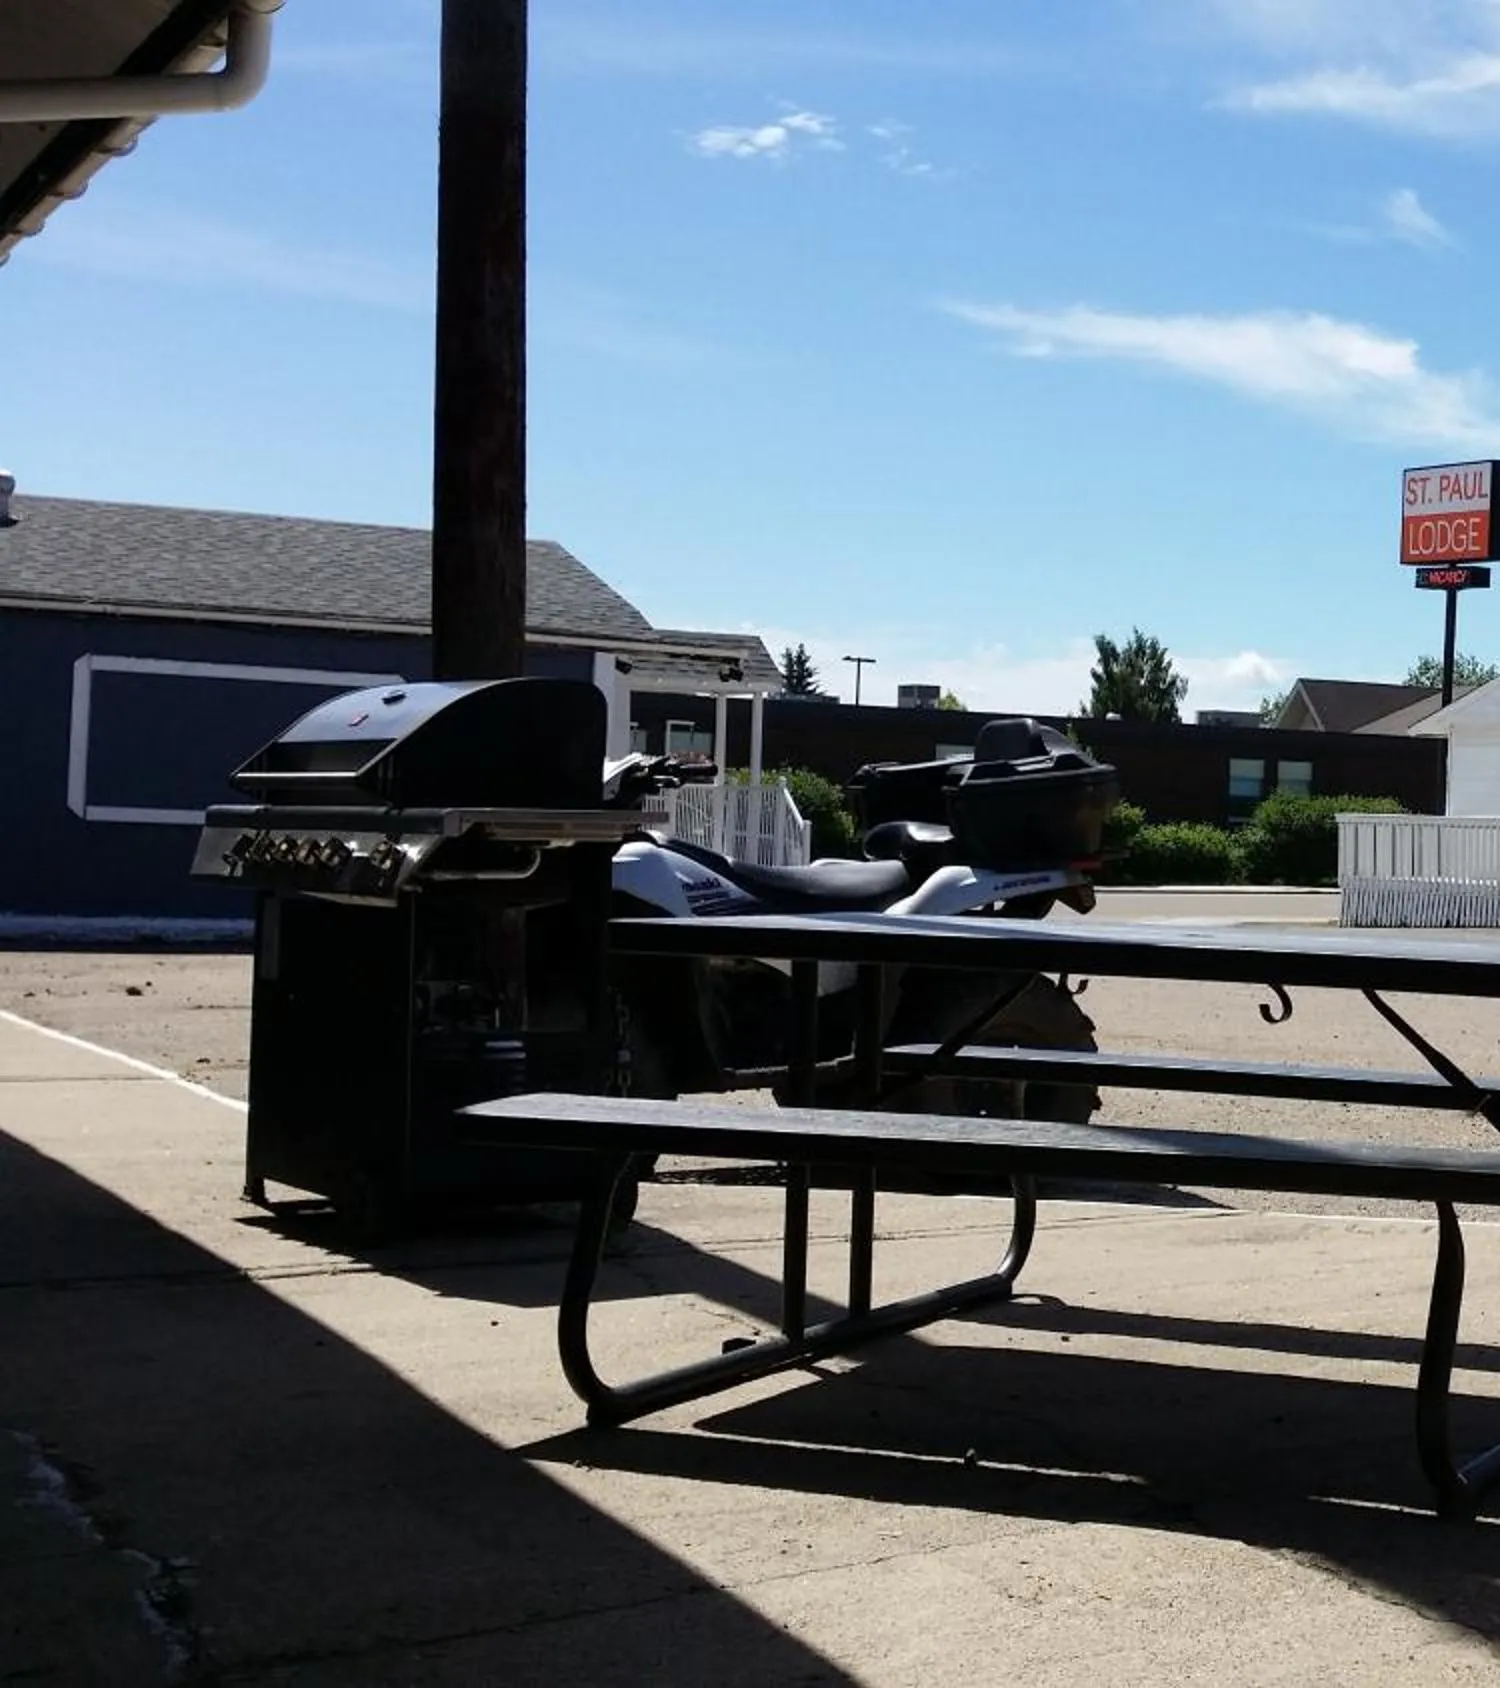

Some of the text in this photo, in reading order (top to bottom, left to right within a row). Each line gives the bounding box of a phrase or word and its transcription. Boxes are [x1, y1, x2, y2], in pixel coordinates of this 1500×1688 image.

[1405, 471, 1488, 506] ST. PAUL
[1408, 517, 1482, 555] LODGE
